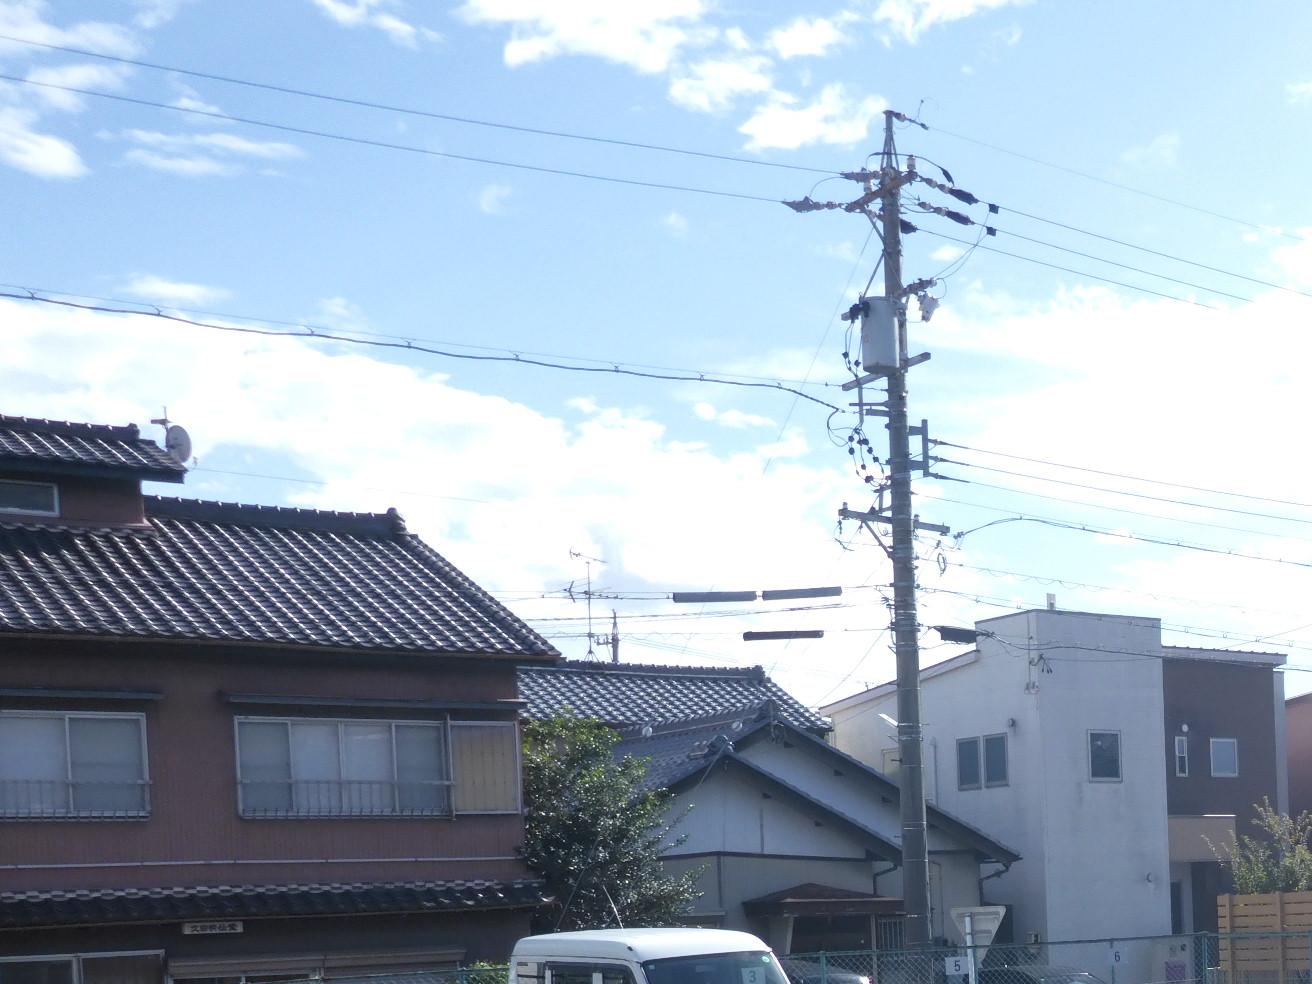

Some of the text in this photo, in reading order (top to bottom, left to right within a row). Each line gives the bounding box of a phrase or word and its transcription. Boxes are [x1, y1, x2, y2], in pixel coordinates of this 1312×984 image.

[1114, 951, 1121, 962] 6
[954, 959, 961, 972] 5
[749, 970, 757, 984] 3
